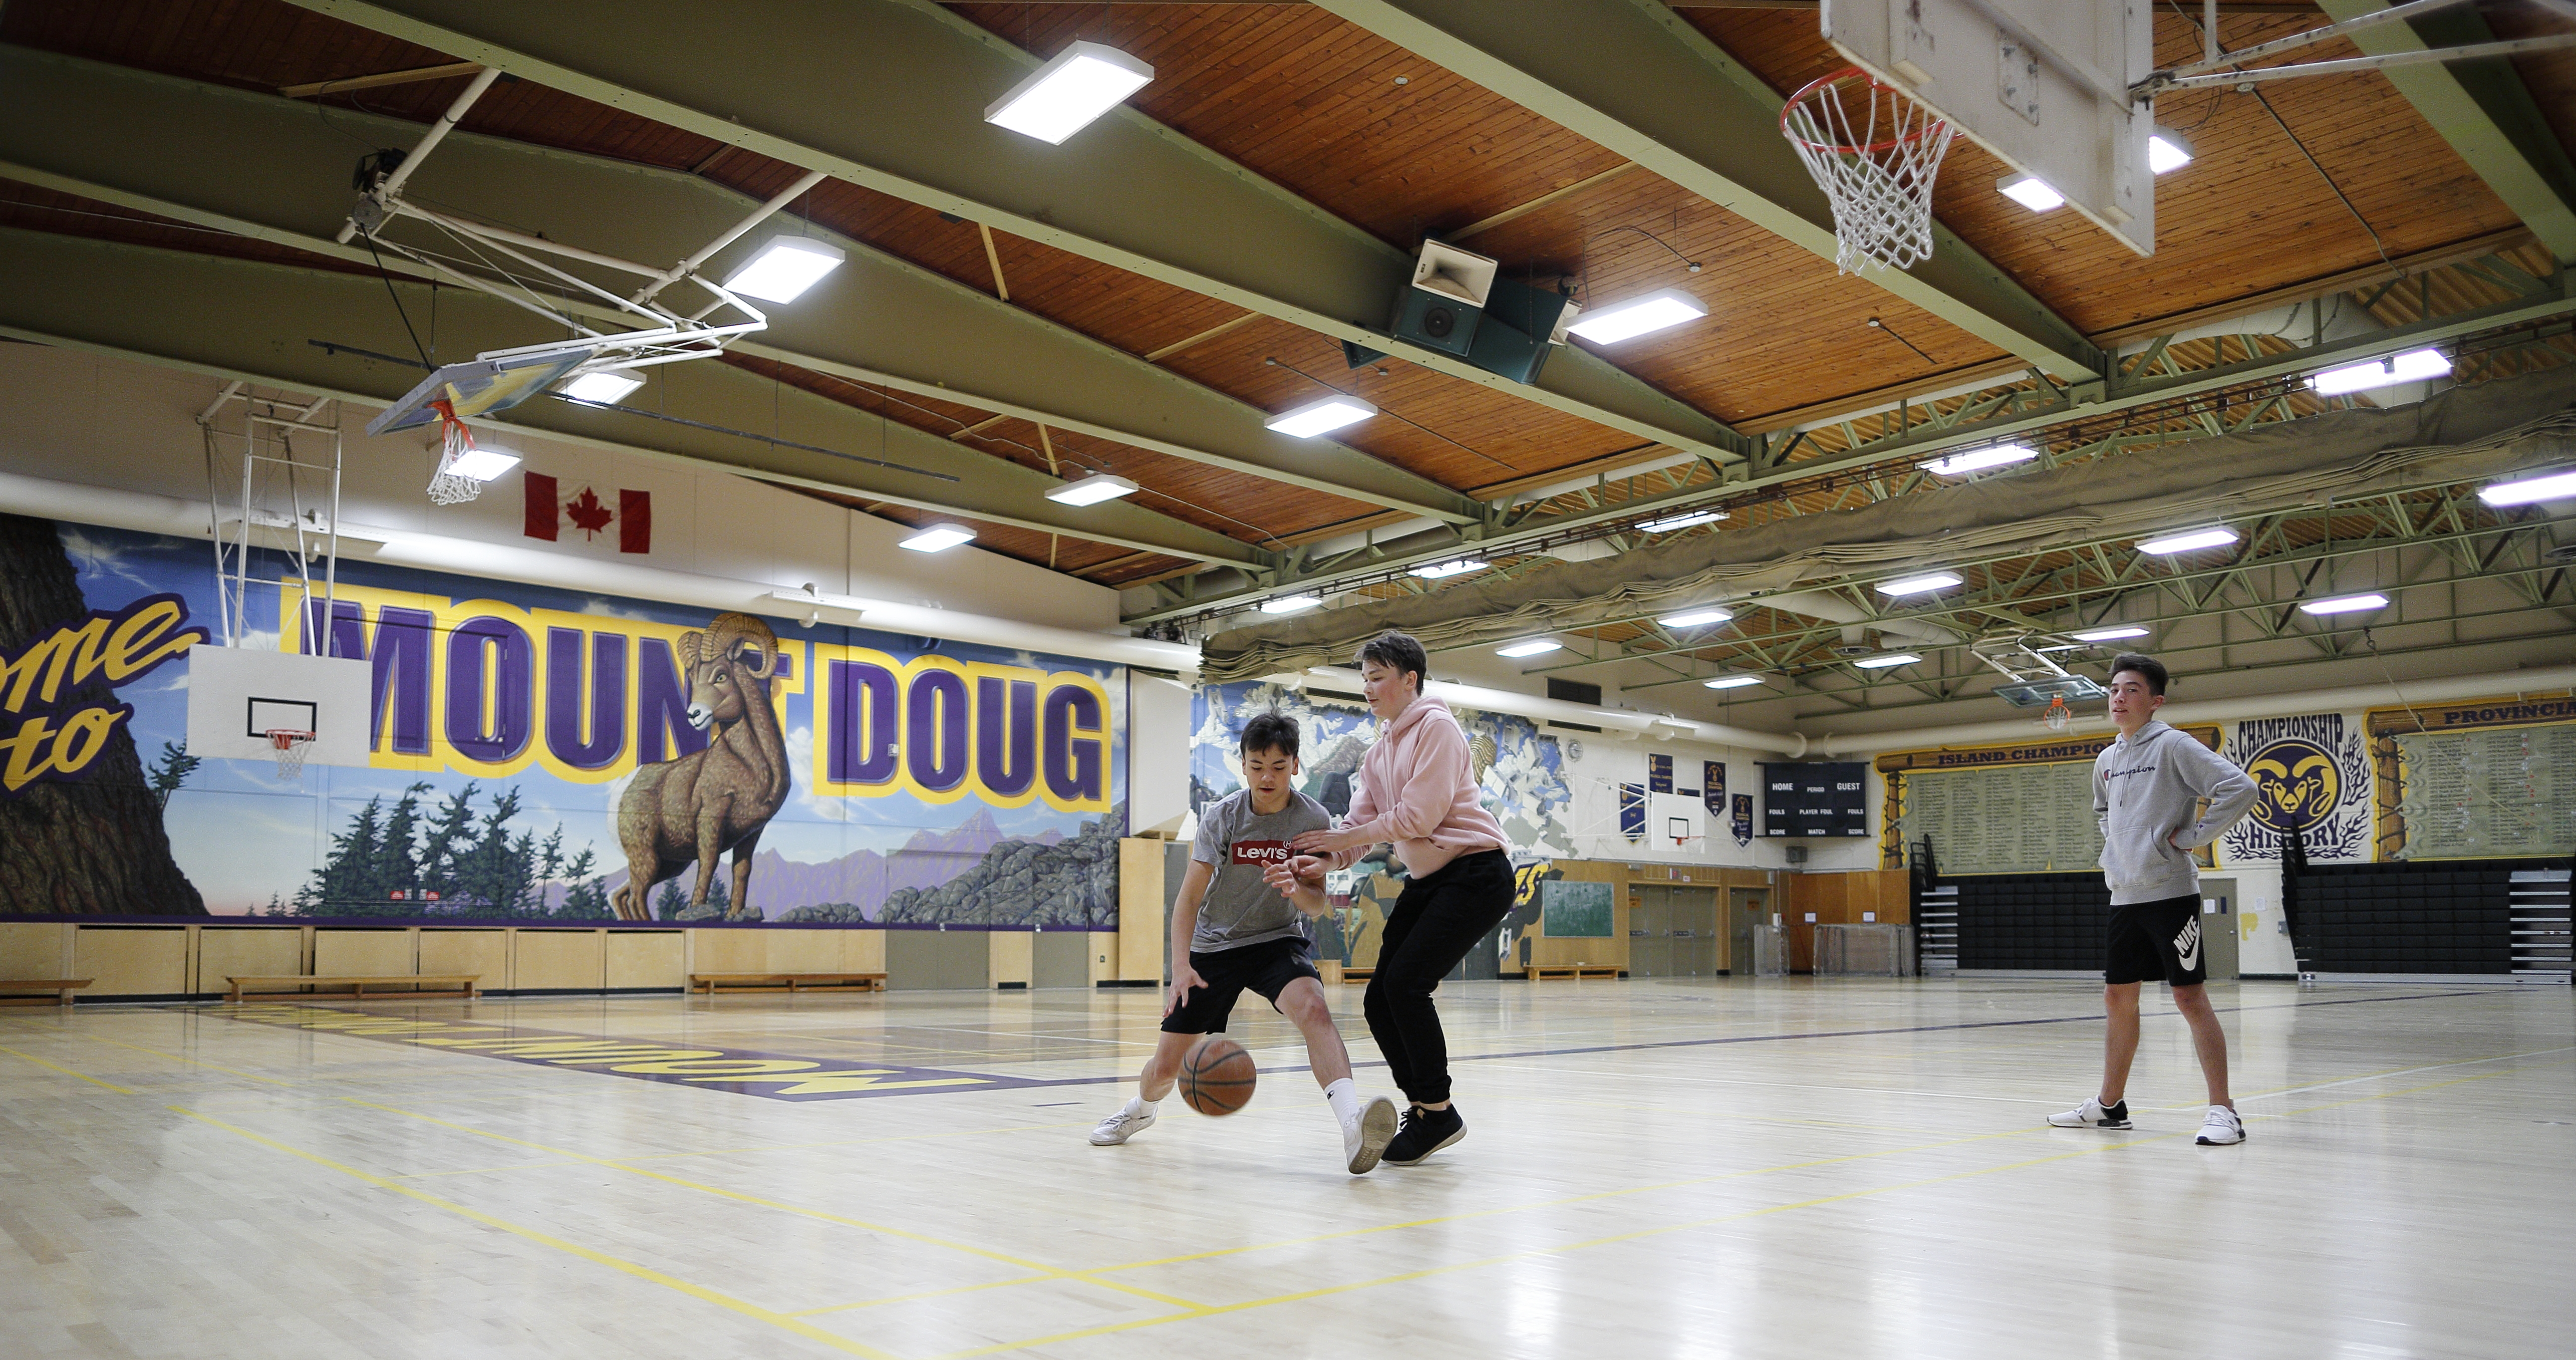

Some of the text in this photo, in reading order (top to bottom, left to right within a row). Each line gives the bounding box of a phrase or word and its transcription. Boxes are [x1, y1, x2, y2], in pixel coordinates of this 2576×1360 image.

[302, 597, 1102, 801] MOUN DOUG
[0, 707, 125, 791] to
[1938, 742, 2116, 765] ISLAND CHAMPIO
[2238, 713, 2344, 763] CHAMPIONSHIP
[1837, 782, 1861, 790] GUEST
[2249, 812, 2340, 849] HISORY
[400, 1036, 998, 1095] MOUNT
